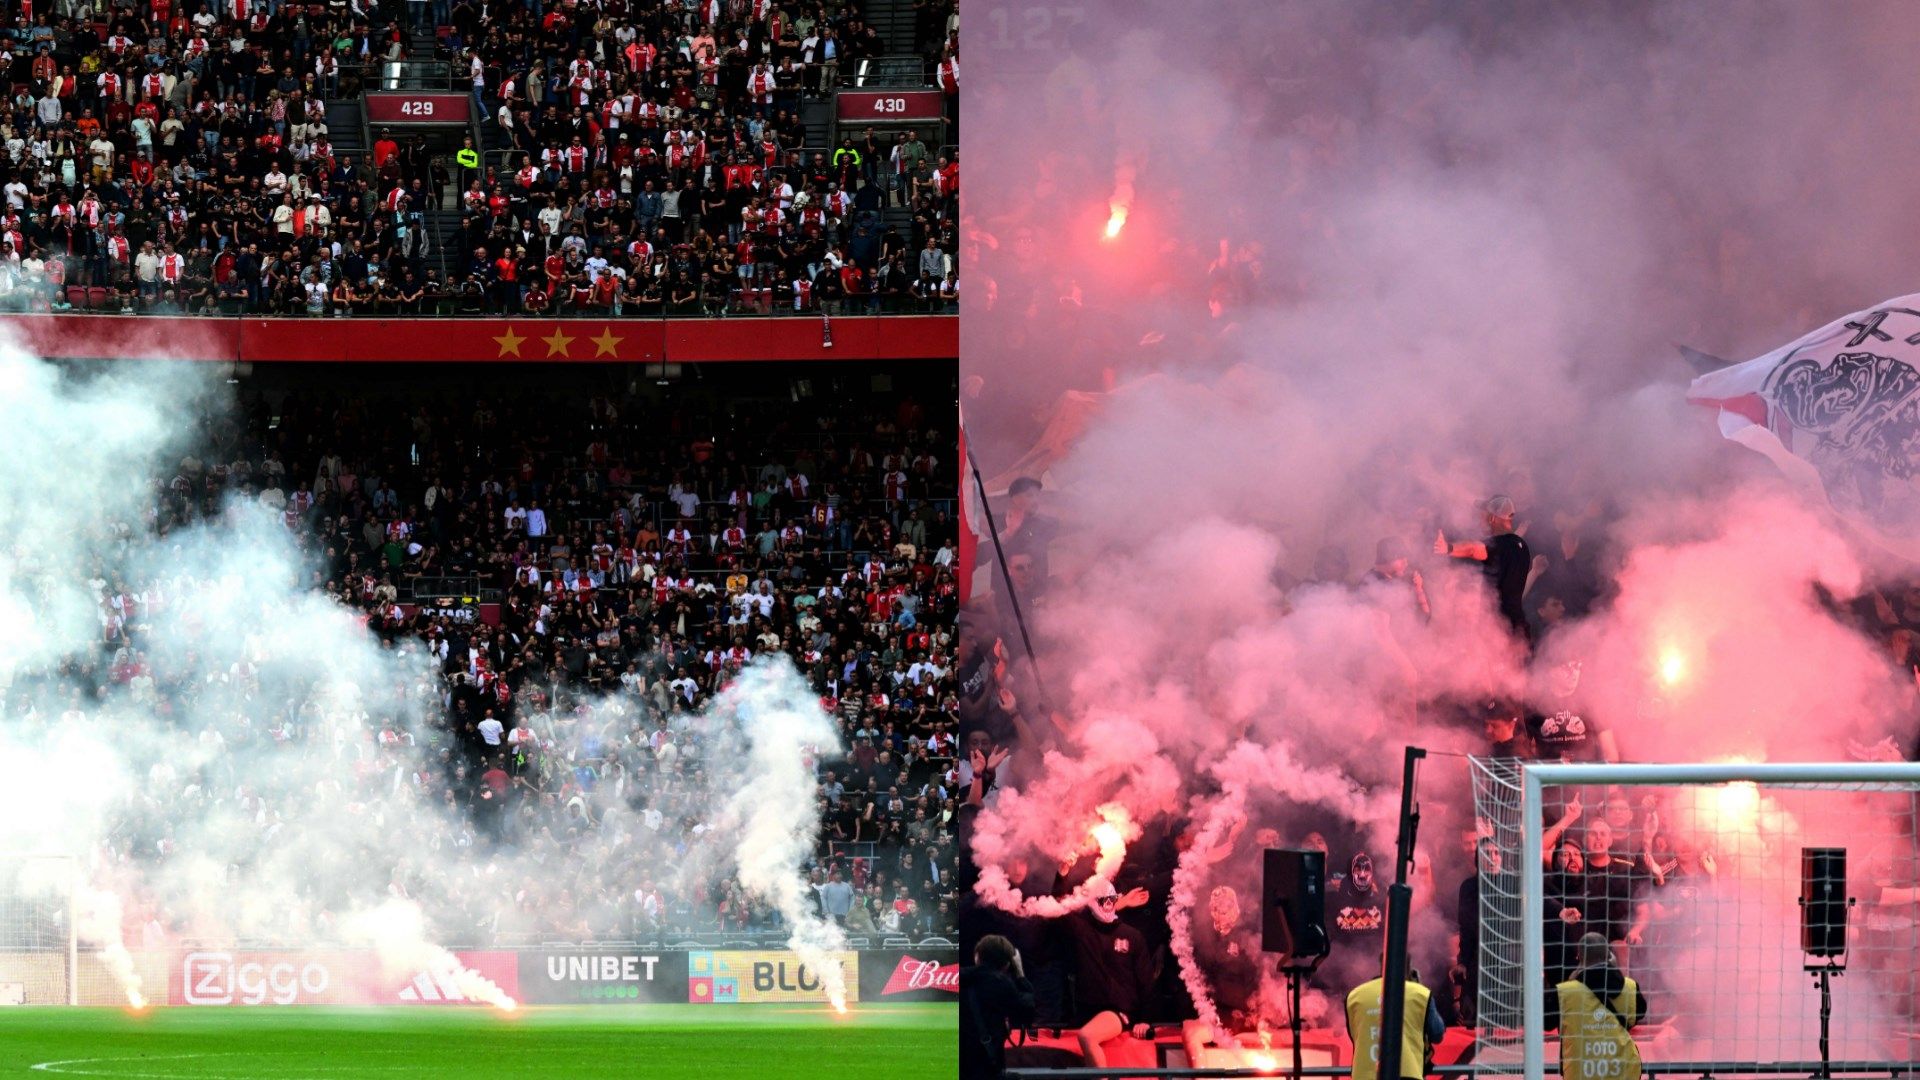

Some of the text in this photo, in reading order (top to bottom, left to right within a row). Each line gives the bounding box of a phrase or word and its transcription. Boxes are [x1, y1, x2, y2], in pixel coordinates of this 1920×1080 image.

[988, 6, 1085, 49] 127
[401, 101, 434, 115] 429
[874, 98, 906, 112] 430
[817, 509, 825, 522] 6
[547, 956, 659, 981] UNIBET
[753, 961, 844, 992] BLO
[184, 952, 329, 1005] Ziggo
[1585, 1041, 1617, 1056] FOTO
[1583, 1059, 1621, 1078] 003
